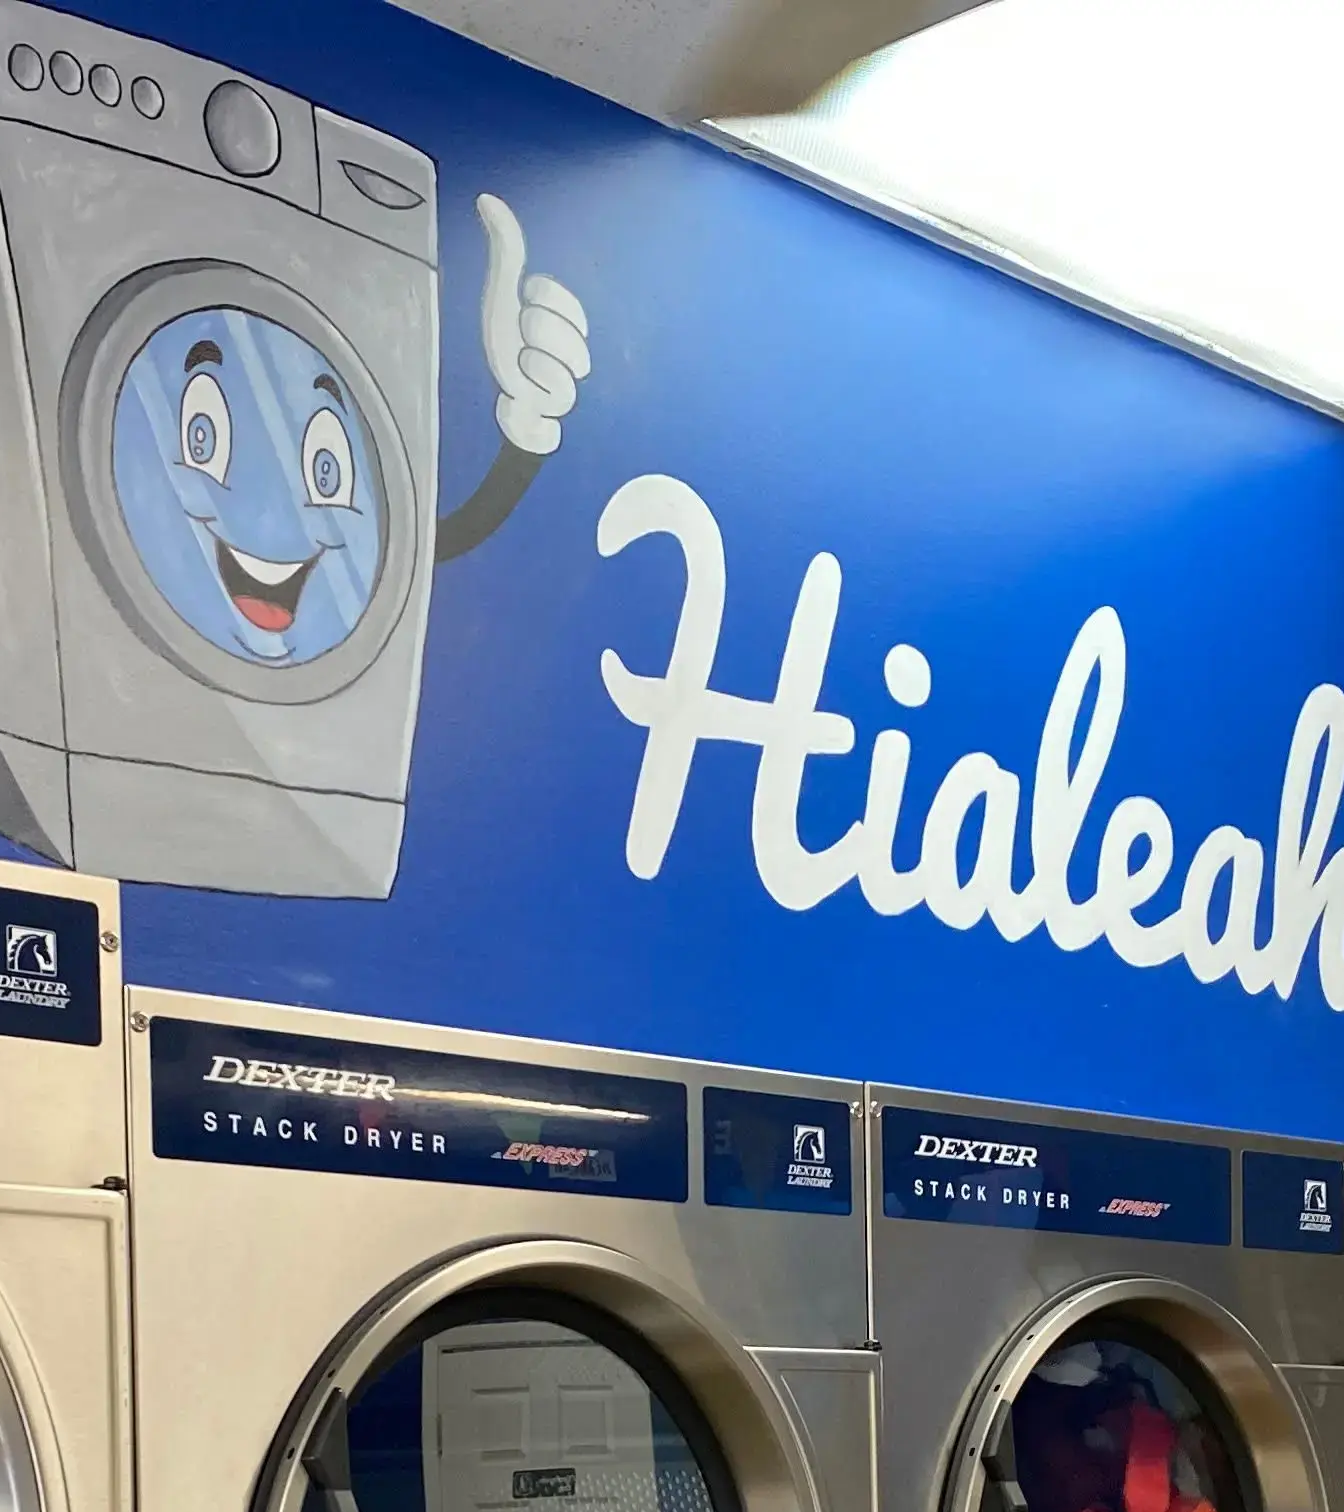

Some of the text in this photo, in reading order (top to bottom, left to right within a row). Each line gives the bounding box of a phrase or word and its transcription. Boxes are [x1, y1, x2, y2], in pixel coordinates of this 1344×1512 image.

[203, 1055, 397, 1102] DEXTER
[203, 1111, 448, 1155] STACK DRYER
[502, 1142, 589, 1167] EXPRESS
[914, 1134, 1037, 1168] DEXTER
[787, 1163, 833, 1178] DEXTER
[787, 1175, 833, 1188] LAUNDRY
[914, 1179, 1071, 1210] STACK DRYER
